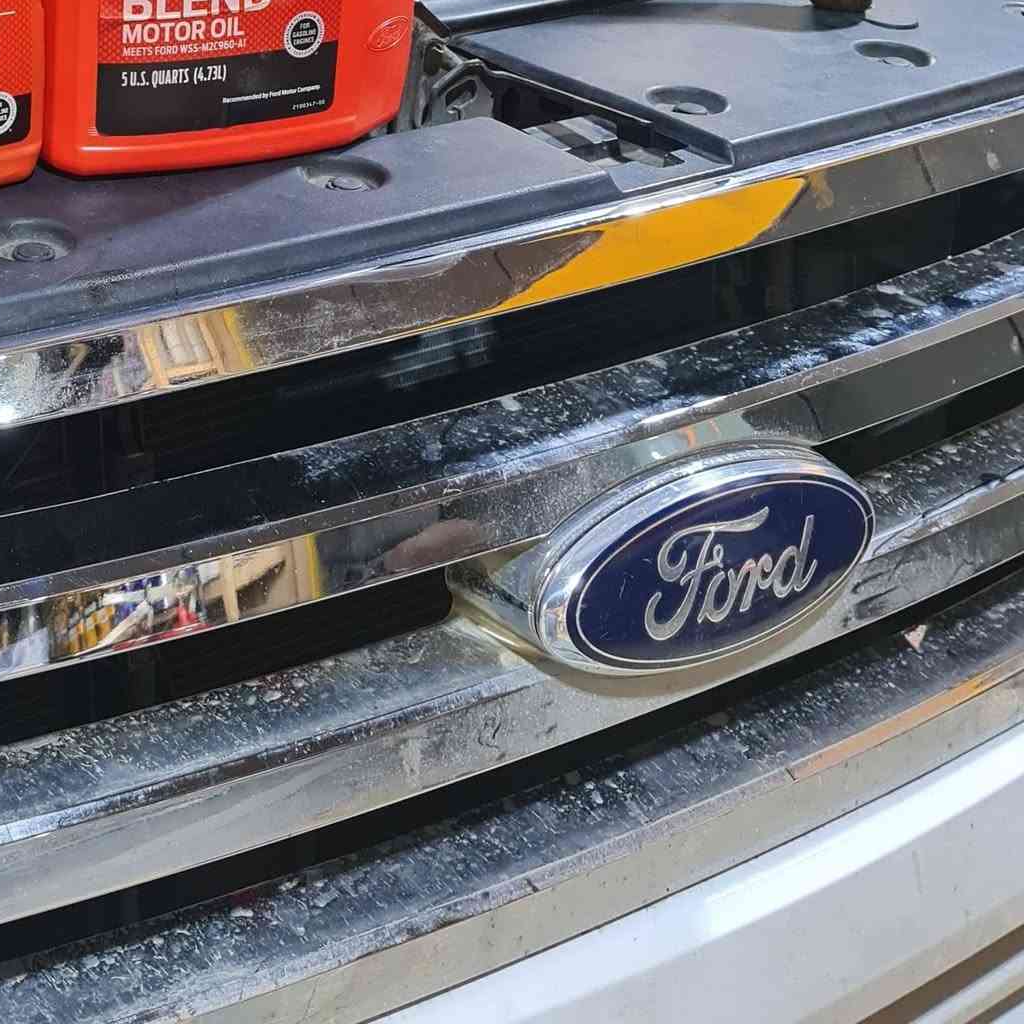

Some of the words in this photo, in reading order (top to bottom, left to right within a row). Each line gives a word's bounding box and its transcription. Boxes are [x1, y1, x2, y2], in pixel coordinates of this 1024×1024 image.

[121, 19, 206, 44] MOTOR
[210, 16, 245, 39] OIL
[122, 46, 153, 57] MEETS
[154, 45, 178, 56] FORD
[121, 71, 128, 87] 5
[129, 70, 149, 86] U.S.
[151, 67, 190, 89] QUARTS
[193, 64, 227, 85] (4.73L)
[643, 506, 818, 641] Ford
